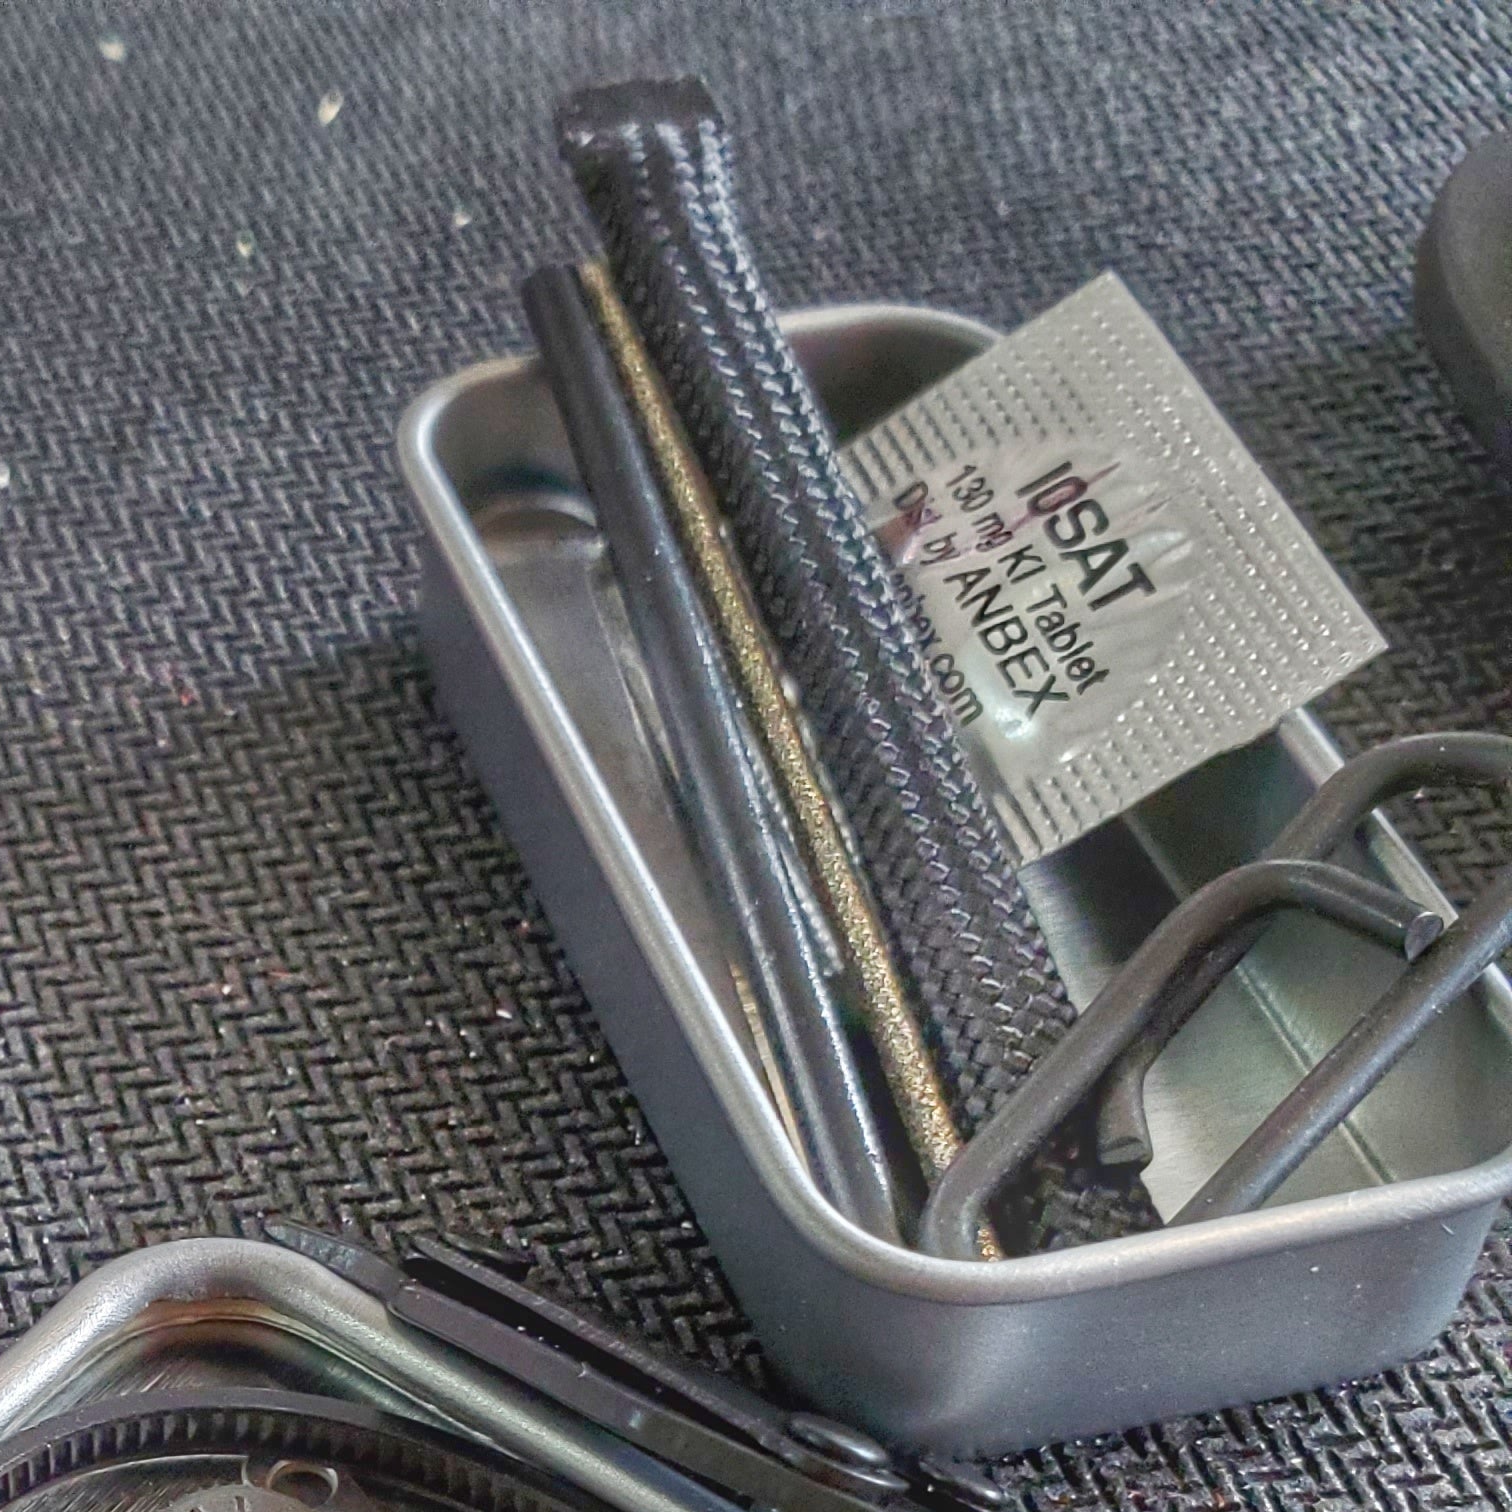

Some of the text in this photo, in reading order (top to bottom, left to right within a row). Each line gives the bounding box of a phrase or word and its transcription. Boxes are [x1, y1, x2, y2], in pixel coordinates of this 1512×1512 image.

[919, 531, 962, 567] by
[943, 566, 1071, 720] ANBEX
[946, 464, 995, 515] 130
[973, 510, 1014, 554] mg
[1026, 583, 1110, 695] Tablet
[1015, 461, 1157, 611] IOSAT
